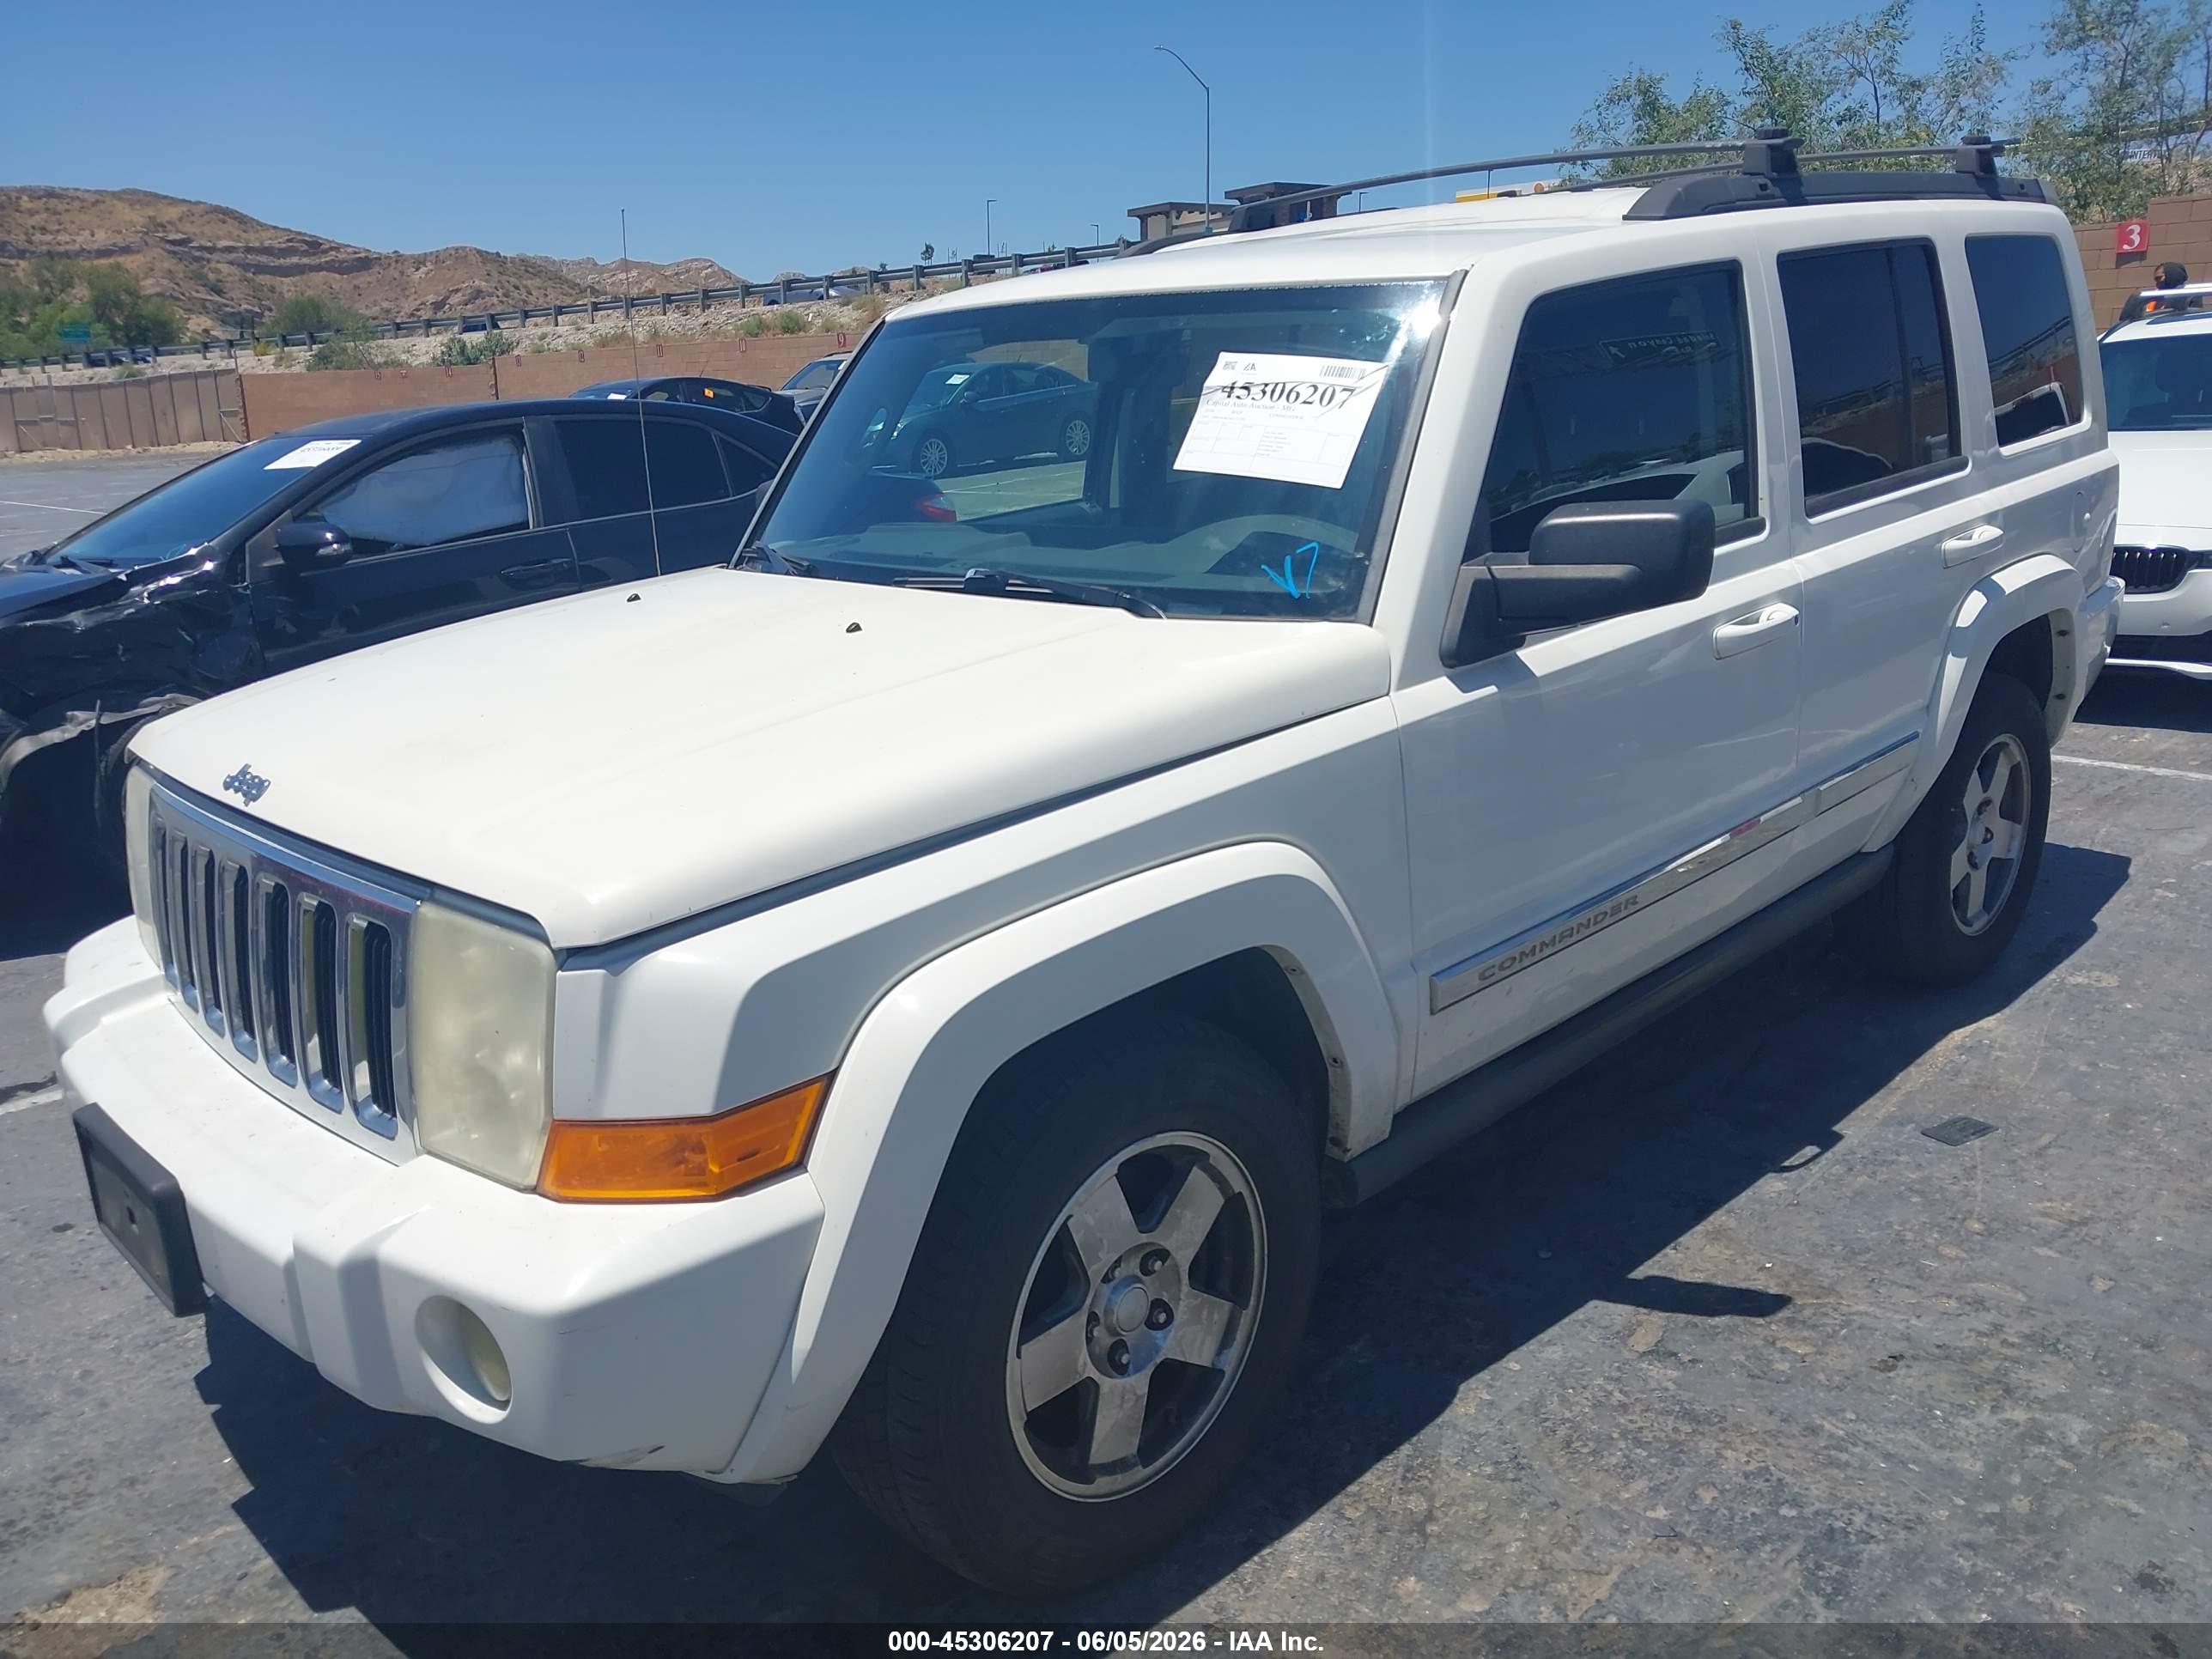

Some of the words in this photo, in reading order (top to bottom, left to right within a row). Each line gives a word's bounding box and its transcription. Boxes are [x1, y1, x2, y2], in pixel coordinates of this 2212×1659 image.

[2123, 224, 2141, 250] 3
[1221, 380, 1355, 410] 45306207
[1478, 895, 1639, 981] COMMANDER
